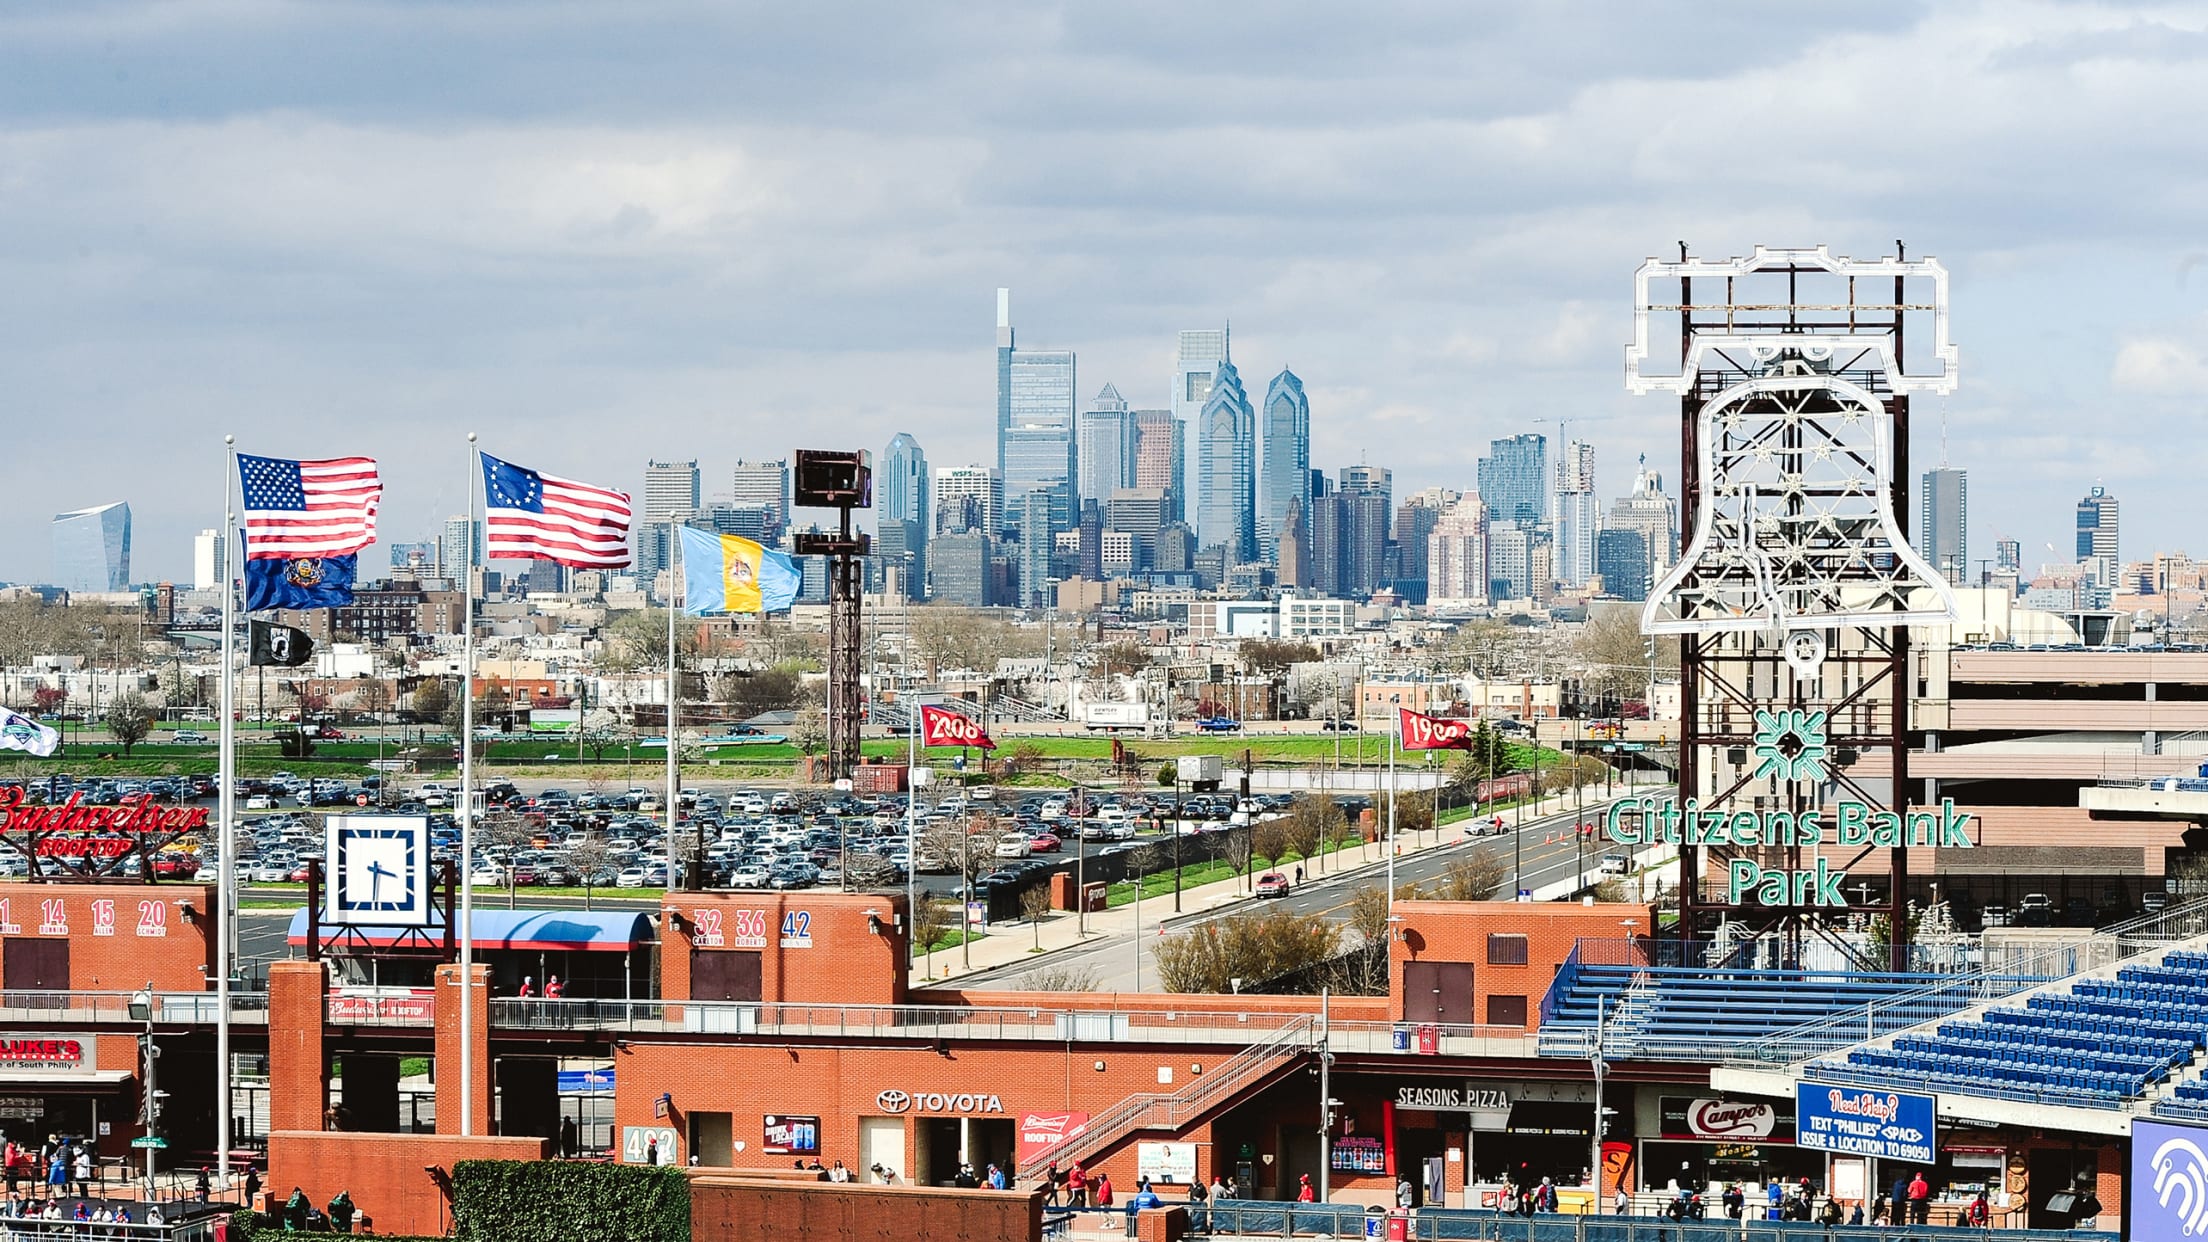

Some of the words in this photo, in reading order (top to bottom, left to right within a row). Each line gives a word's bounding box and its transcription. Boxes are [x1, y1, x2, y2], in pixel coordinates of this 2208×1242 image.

[0, 785, 210, 834] Budweiser
[1606, 798, 1822, 847] Citizens
[1836, 797, 1975, 849] Bank
[37, 838, 135, 857] ROOFTOP
[1728, 857, 1849, 907] Park
[0, 898, 10, 924] 1
[41, 898, 66, 925] 14
[91, 899, 115, 927] 15
[138, 900, 166, 928] 20
[694, 909, 722, 936] 32
[736, 910, 765, 937] 36
[138, 928, 165, 936] SCHMIDT
[781, 911, 810, 938] 42
[693, 937, 722, 945] CARLTON
[736, 938, 765, 946] ROBERTS
[0, 1039, 80, 1054] LUKE'S
[48, 1061, 72, 1070] Philly
[913, 1093, 1004, 1113] TOYOTA
[1399, 1087, 1460, 1106] SEASONS
[1467, 1090, 1508, 1108] PIZZA
[1829, 1089, 1861, 1113] Need
[1861, 1093, 1899, 1124] Help?
[1696, 1101, 1767, 1133] Campo's
[1810, 1116, 1833, 1132] TEXT
[1833, 1119, 1881, 1137] "PHILLIES"
[1881, 1125, 1923, 1142] <SPACE>
[765, 1125, 787, 1136] DRINK
[771, 1132, 794, 1143] LOCAL
[1024, 1133, 1063, 1143] ROOFTOP
[626, 1129, 674, 1161] 482
[1801, 1131, 1826, 1146] ISSUE
[1828, 1136, 1836, 1147] &
[1838, 1136, 1884, 1154] LOCATION
[1886, 1142, 1899, 1156] TO
[1900, 1143, 1930, 1160] 69050
[1606, 1152, 1621, 1173] S
